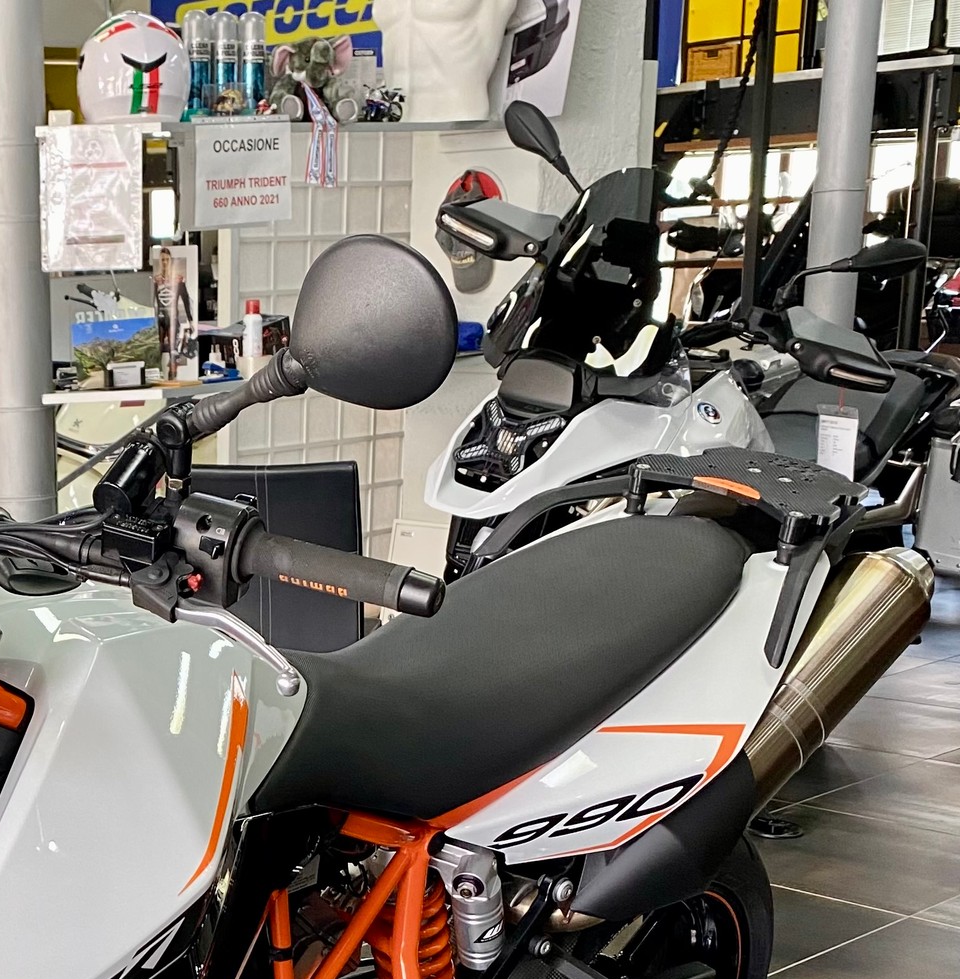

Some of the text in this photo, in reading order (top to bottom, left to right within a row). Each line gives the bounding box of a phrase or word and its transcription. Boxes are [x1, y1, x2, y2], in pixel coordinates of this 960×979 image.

[213, 138, 280, 153] OCCASIONE
[206, 175, 287, 191] TRIUMPH TRIDENT
[213, 194, 280, 208] 660 ANNO 2021
[486, 772, 705, 850] 990
